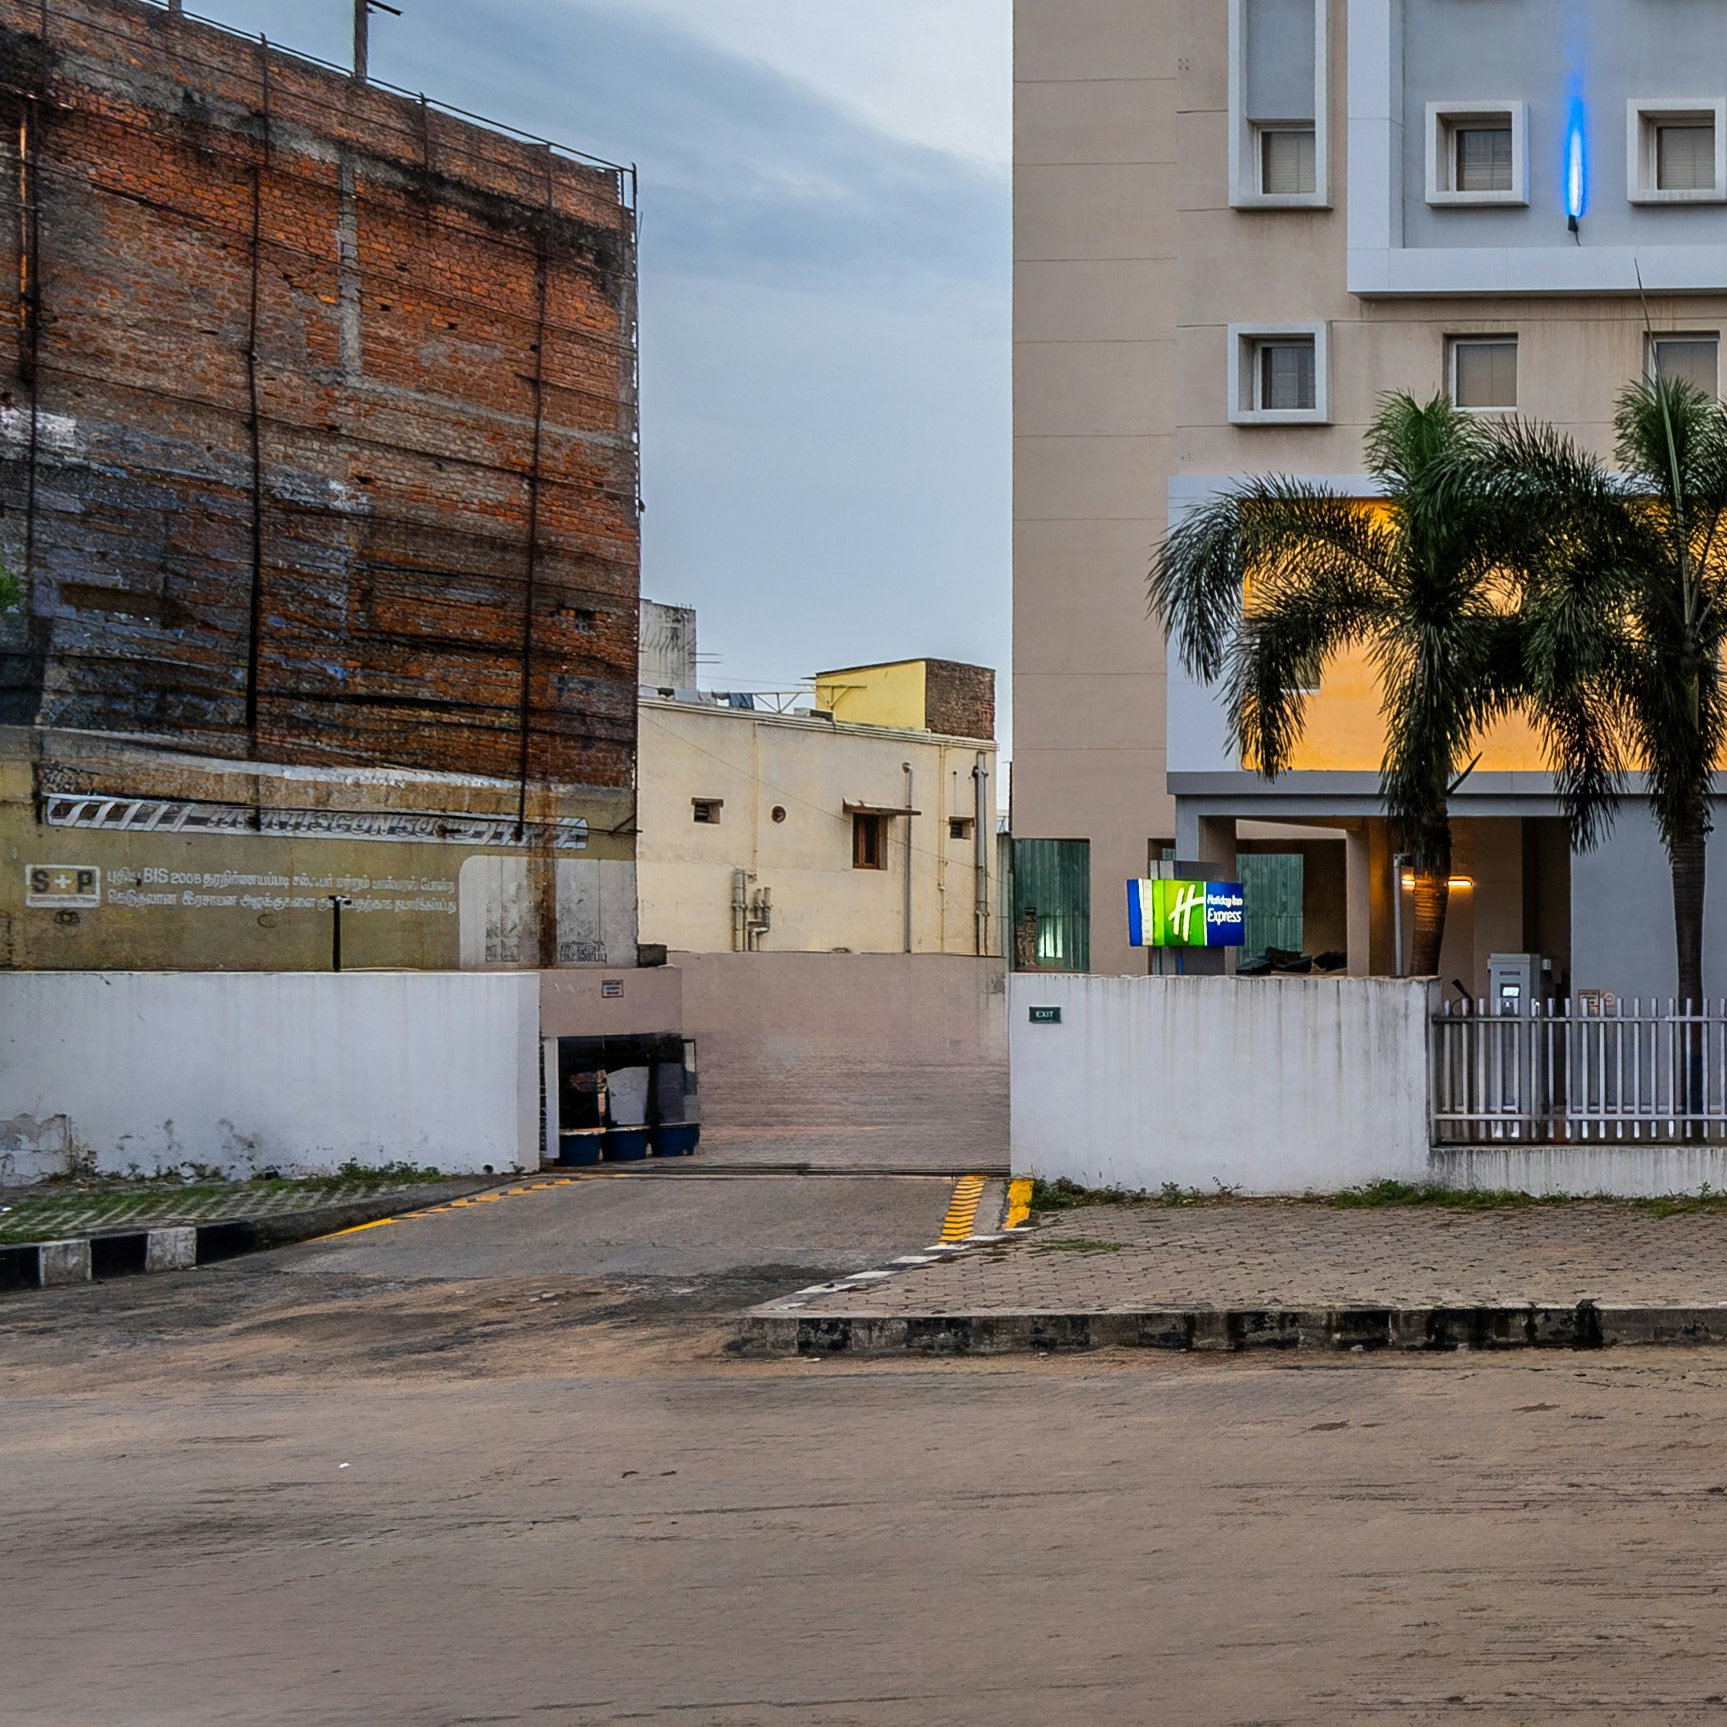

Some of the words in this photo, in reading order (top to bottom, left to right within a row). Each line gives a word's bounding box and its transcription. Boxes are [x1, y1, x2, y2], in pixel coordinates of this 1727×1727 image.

[144, 867, 169, 883] BIS
[1207, 908, 1242, 925] Express
[1036, 1010, 1054, 1018] EXIT
